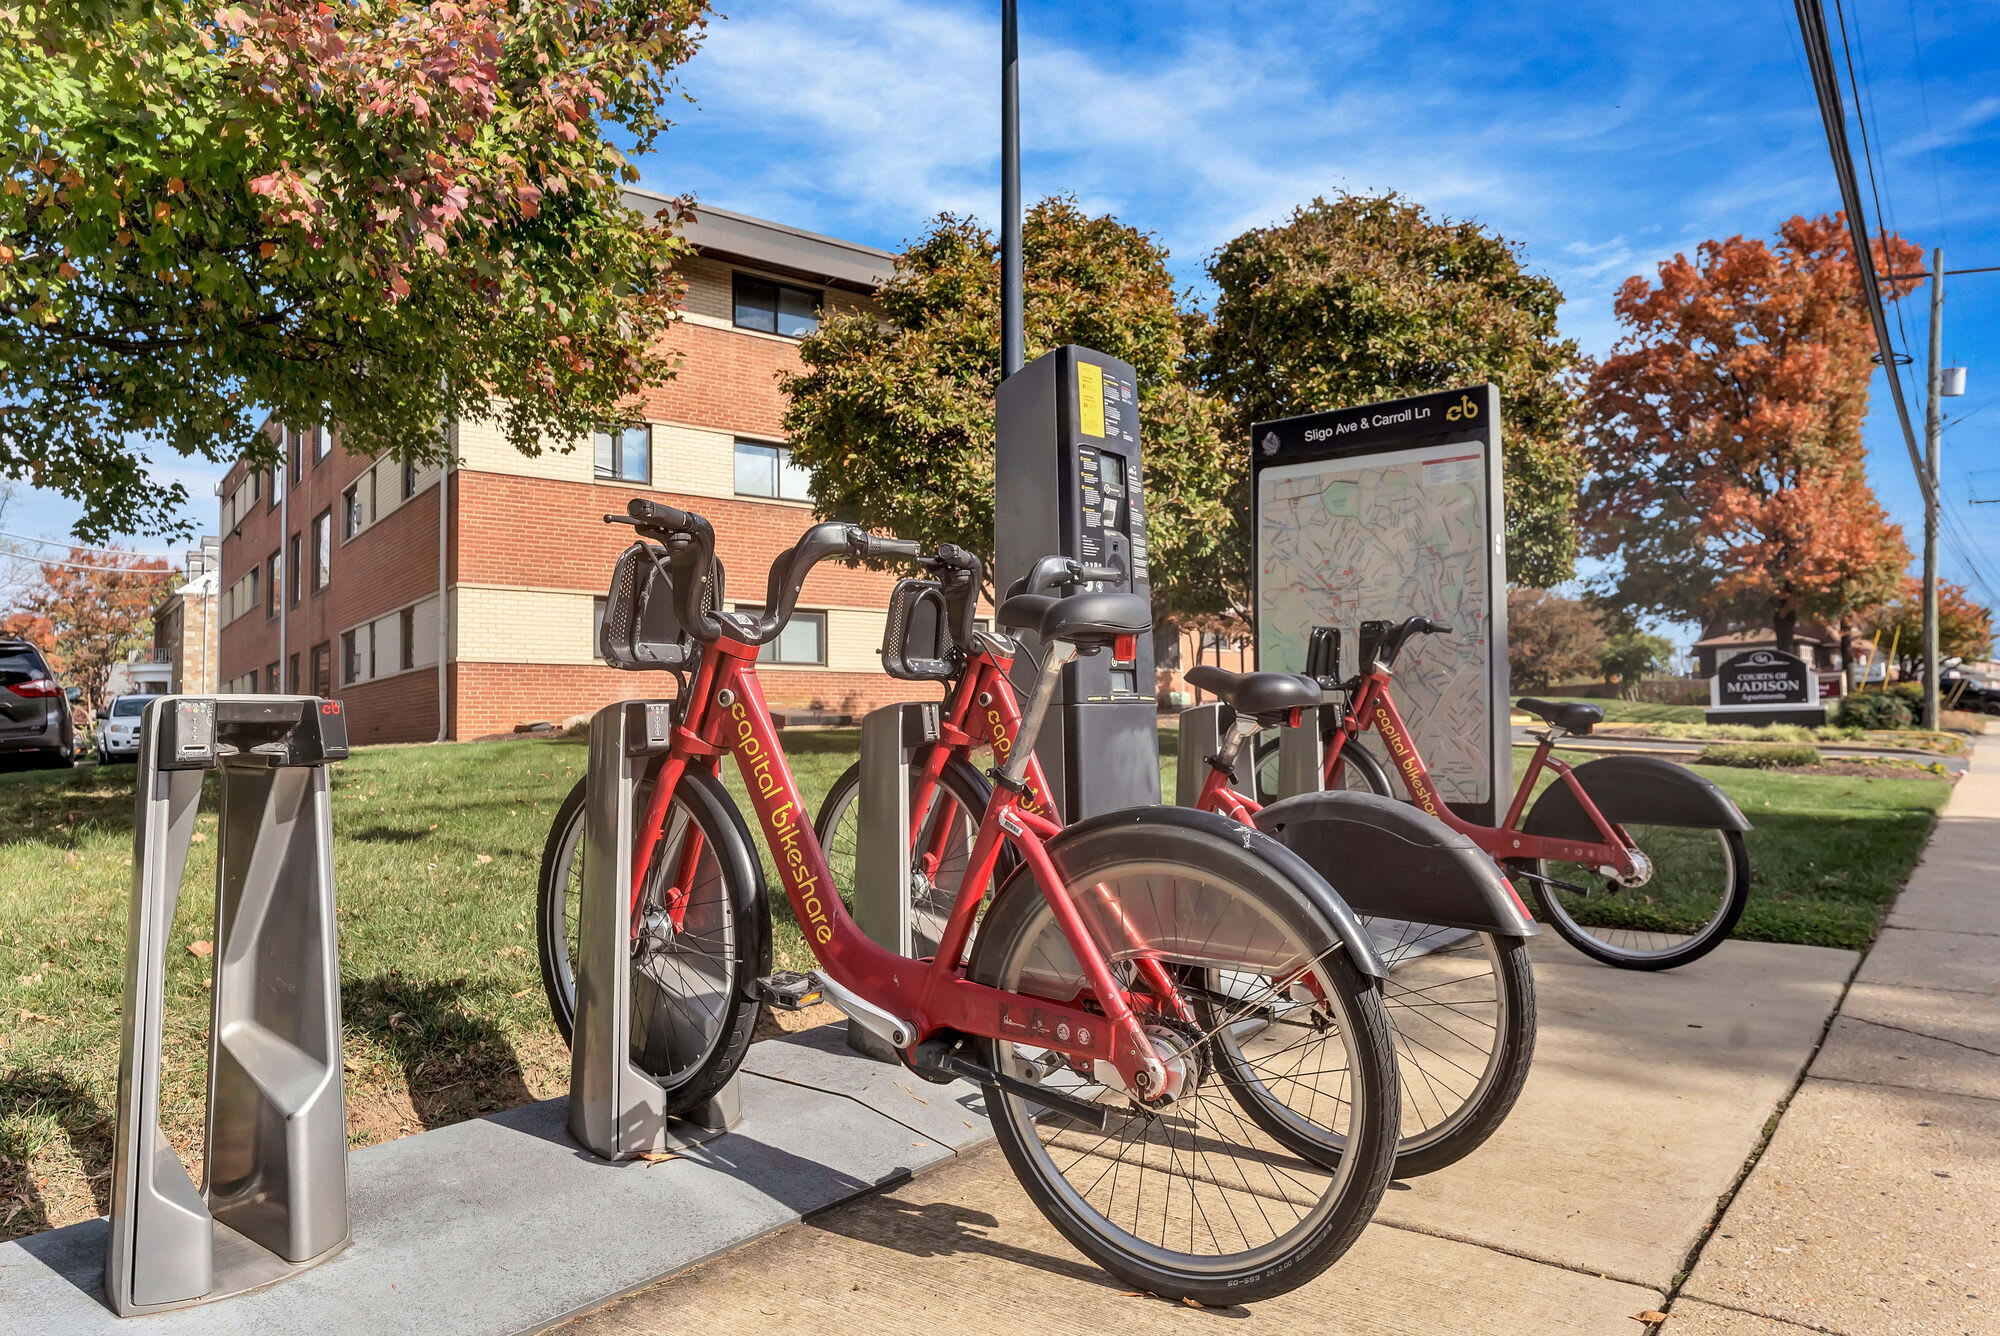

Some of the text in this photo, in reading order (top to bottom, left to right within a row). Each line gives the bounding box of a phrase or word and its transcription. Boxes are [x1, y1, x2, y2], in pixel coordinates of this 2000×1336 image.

[1304, 407, 1431, 442] Sligo Ave & Carroll Ln
[1727, 680, 1800, 693] MADISON
[1736, 672, 1788, 681] COURTS OF
[1741, 693, 1787, 702] Apartments
[1376, 708, 1410, 757] capital
[731, 702, 832, 945] capital bikeshare
